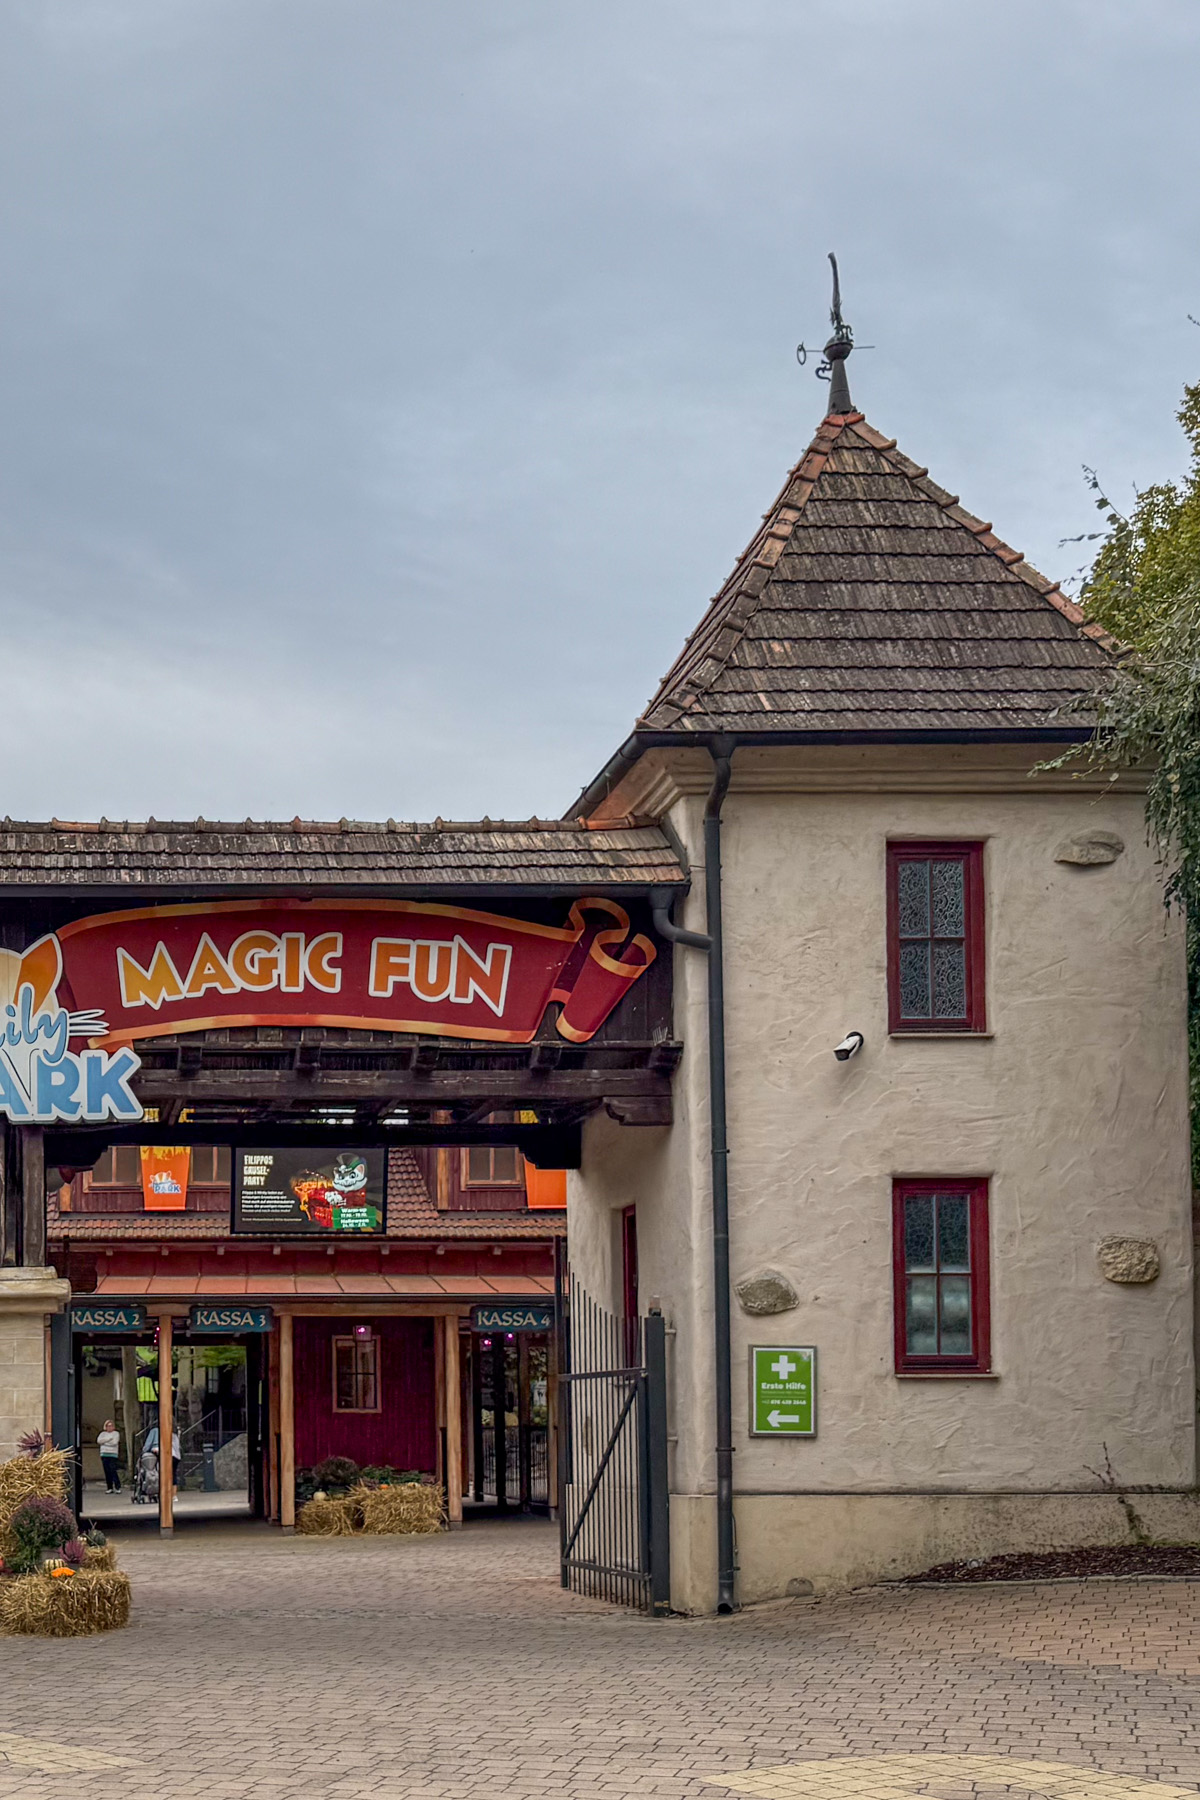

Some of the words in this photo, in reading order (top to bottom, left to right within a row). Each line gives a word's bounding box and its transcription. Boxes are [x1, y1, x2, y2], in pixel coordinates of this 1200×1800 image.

[116, 930, 343, 1010] MAGIC
[368, 935, 513, 1018] FUN
[243, 1154, 274, 1166] FILIPPOS
[243, 1175, 266, 1186] PARTY
[70, 1310, 129, 1327] KASSA
[131, 1314, 141, 1326] 2
[196, 1310, 255, 1327] KASSA
[259, 1314, 266, 1328] 3
[477, 1310, 538, 1327] KASSA
[540, 1313, 551, 1327] 4
[761, 1382, 784, 1390] Erste
[785, 1382, 806, 1390] Hilfe
